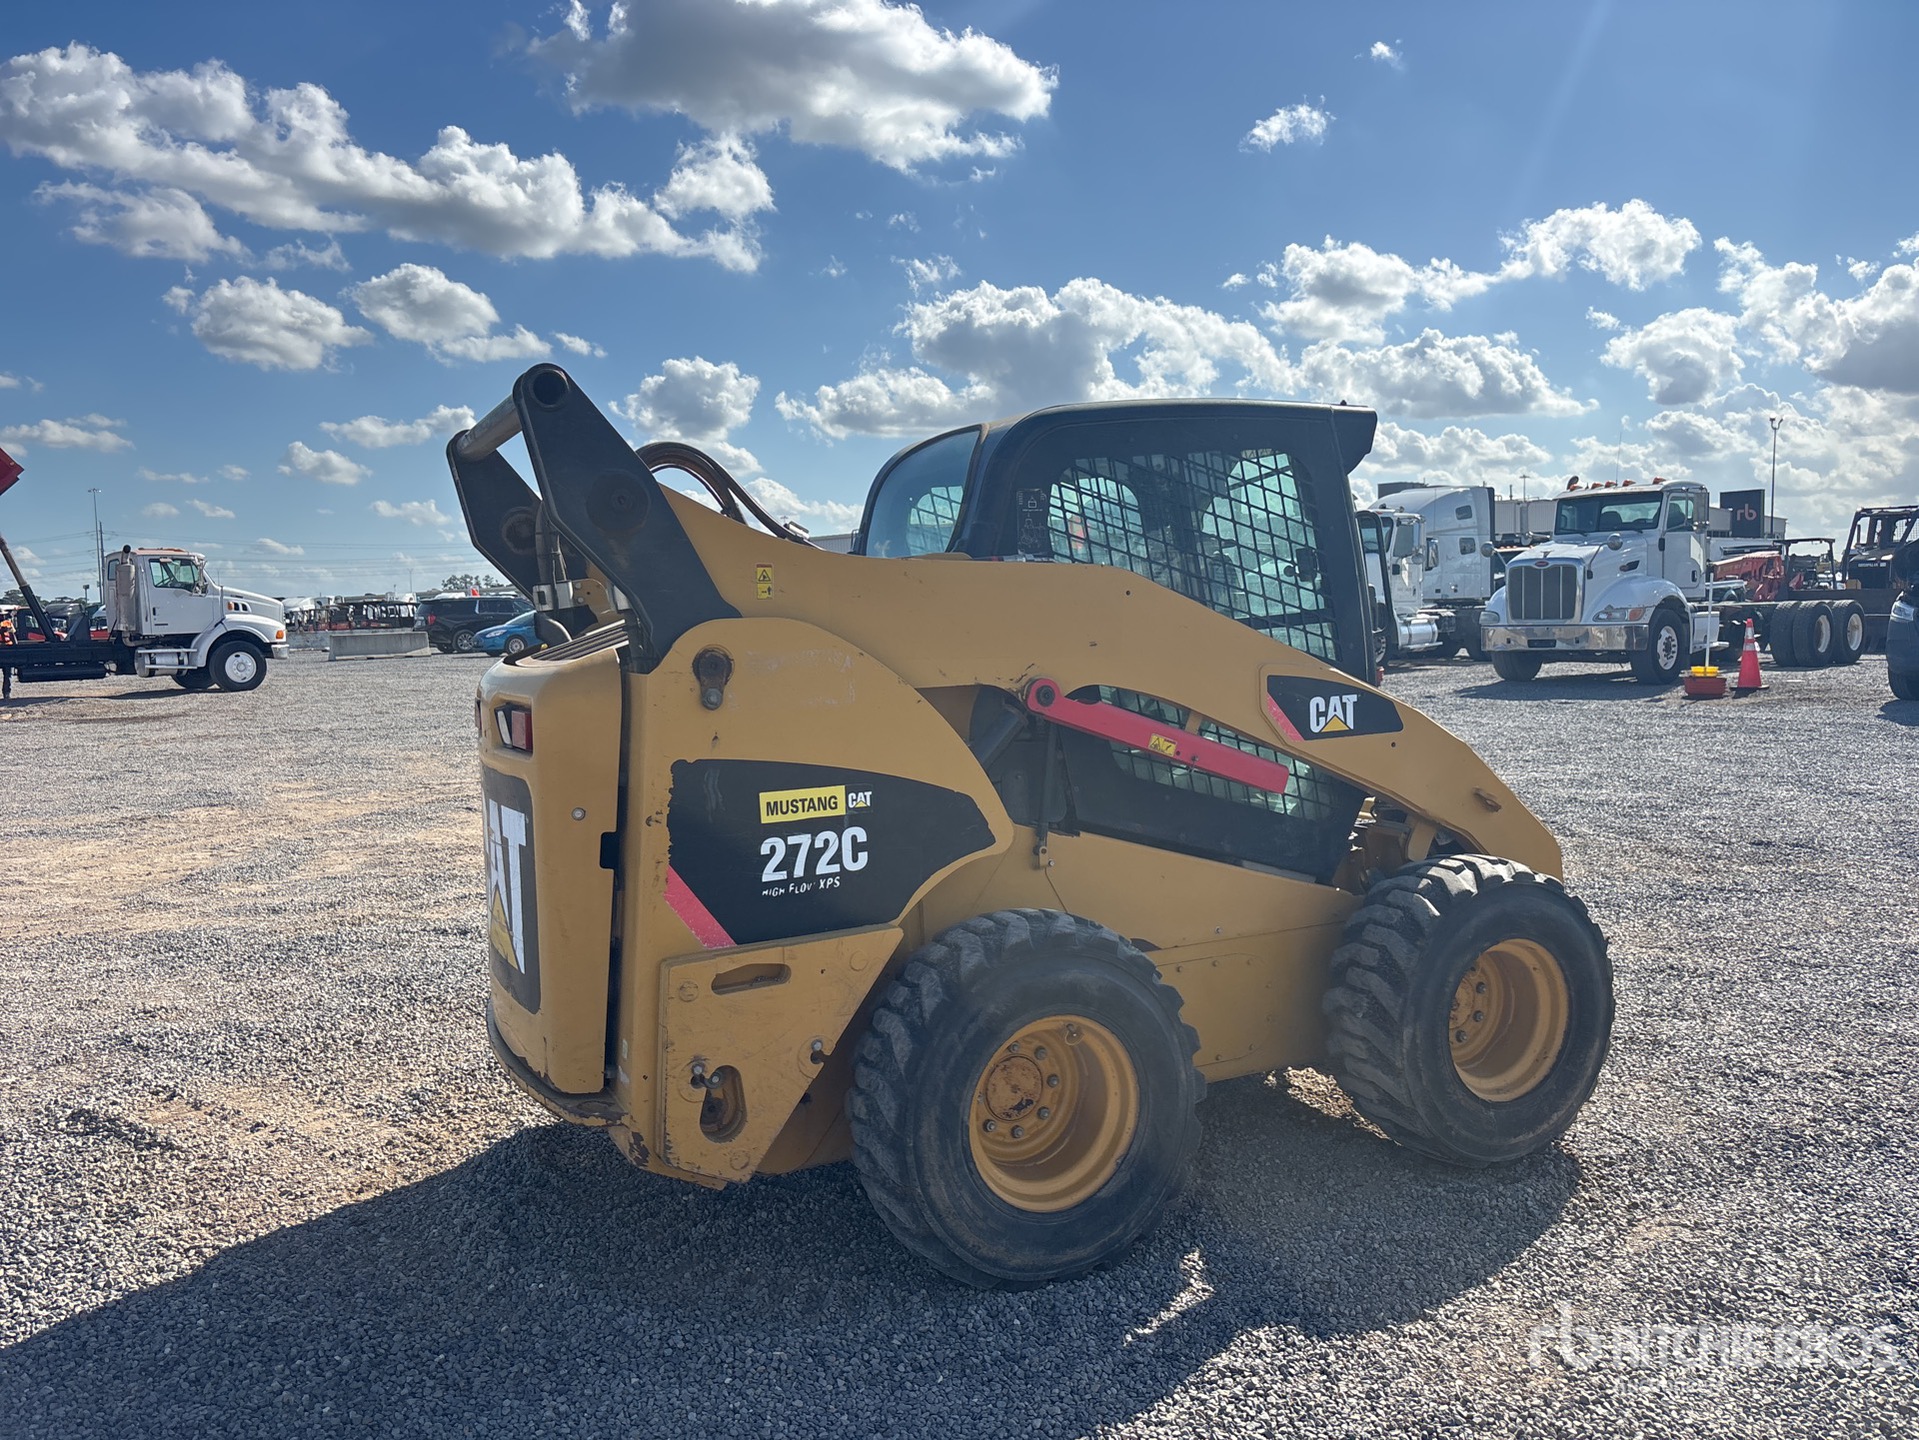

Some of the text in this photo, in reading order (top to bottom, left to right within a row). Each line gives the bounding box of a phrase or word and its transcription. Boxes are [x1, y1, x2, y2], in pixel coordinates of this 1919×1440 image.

[1736, 503, 1757, 521] rb
[1309, 694, 1358, 733] CAT
[766, 791, 872, 817] MUSTANG CAT
[760, 826, 868, 882] 272C
[818, 876, 841, 890] XPS
